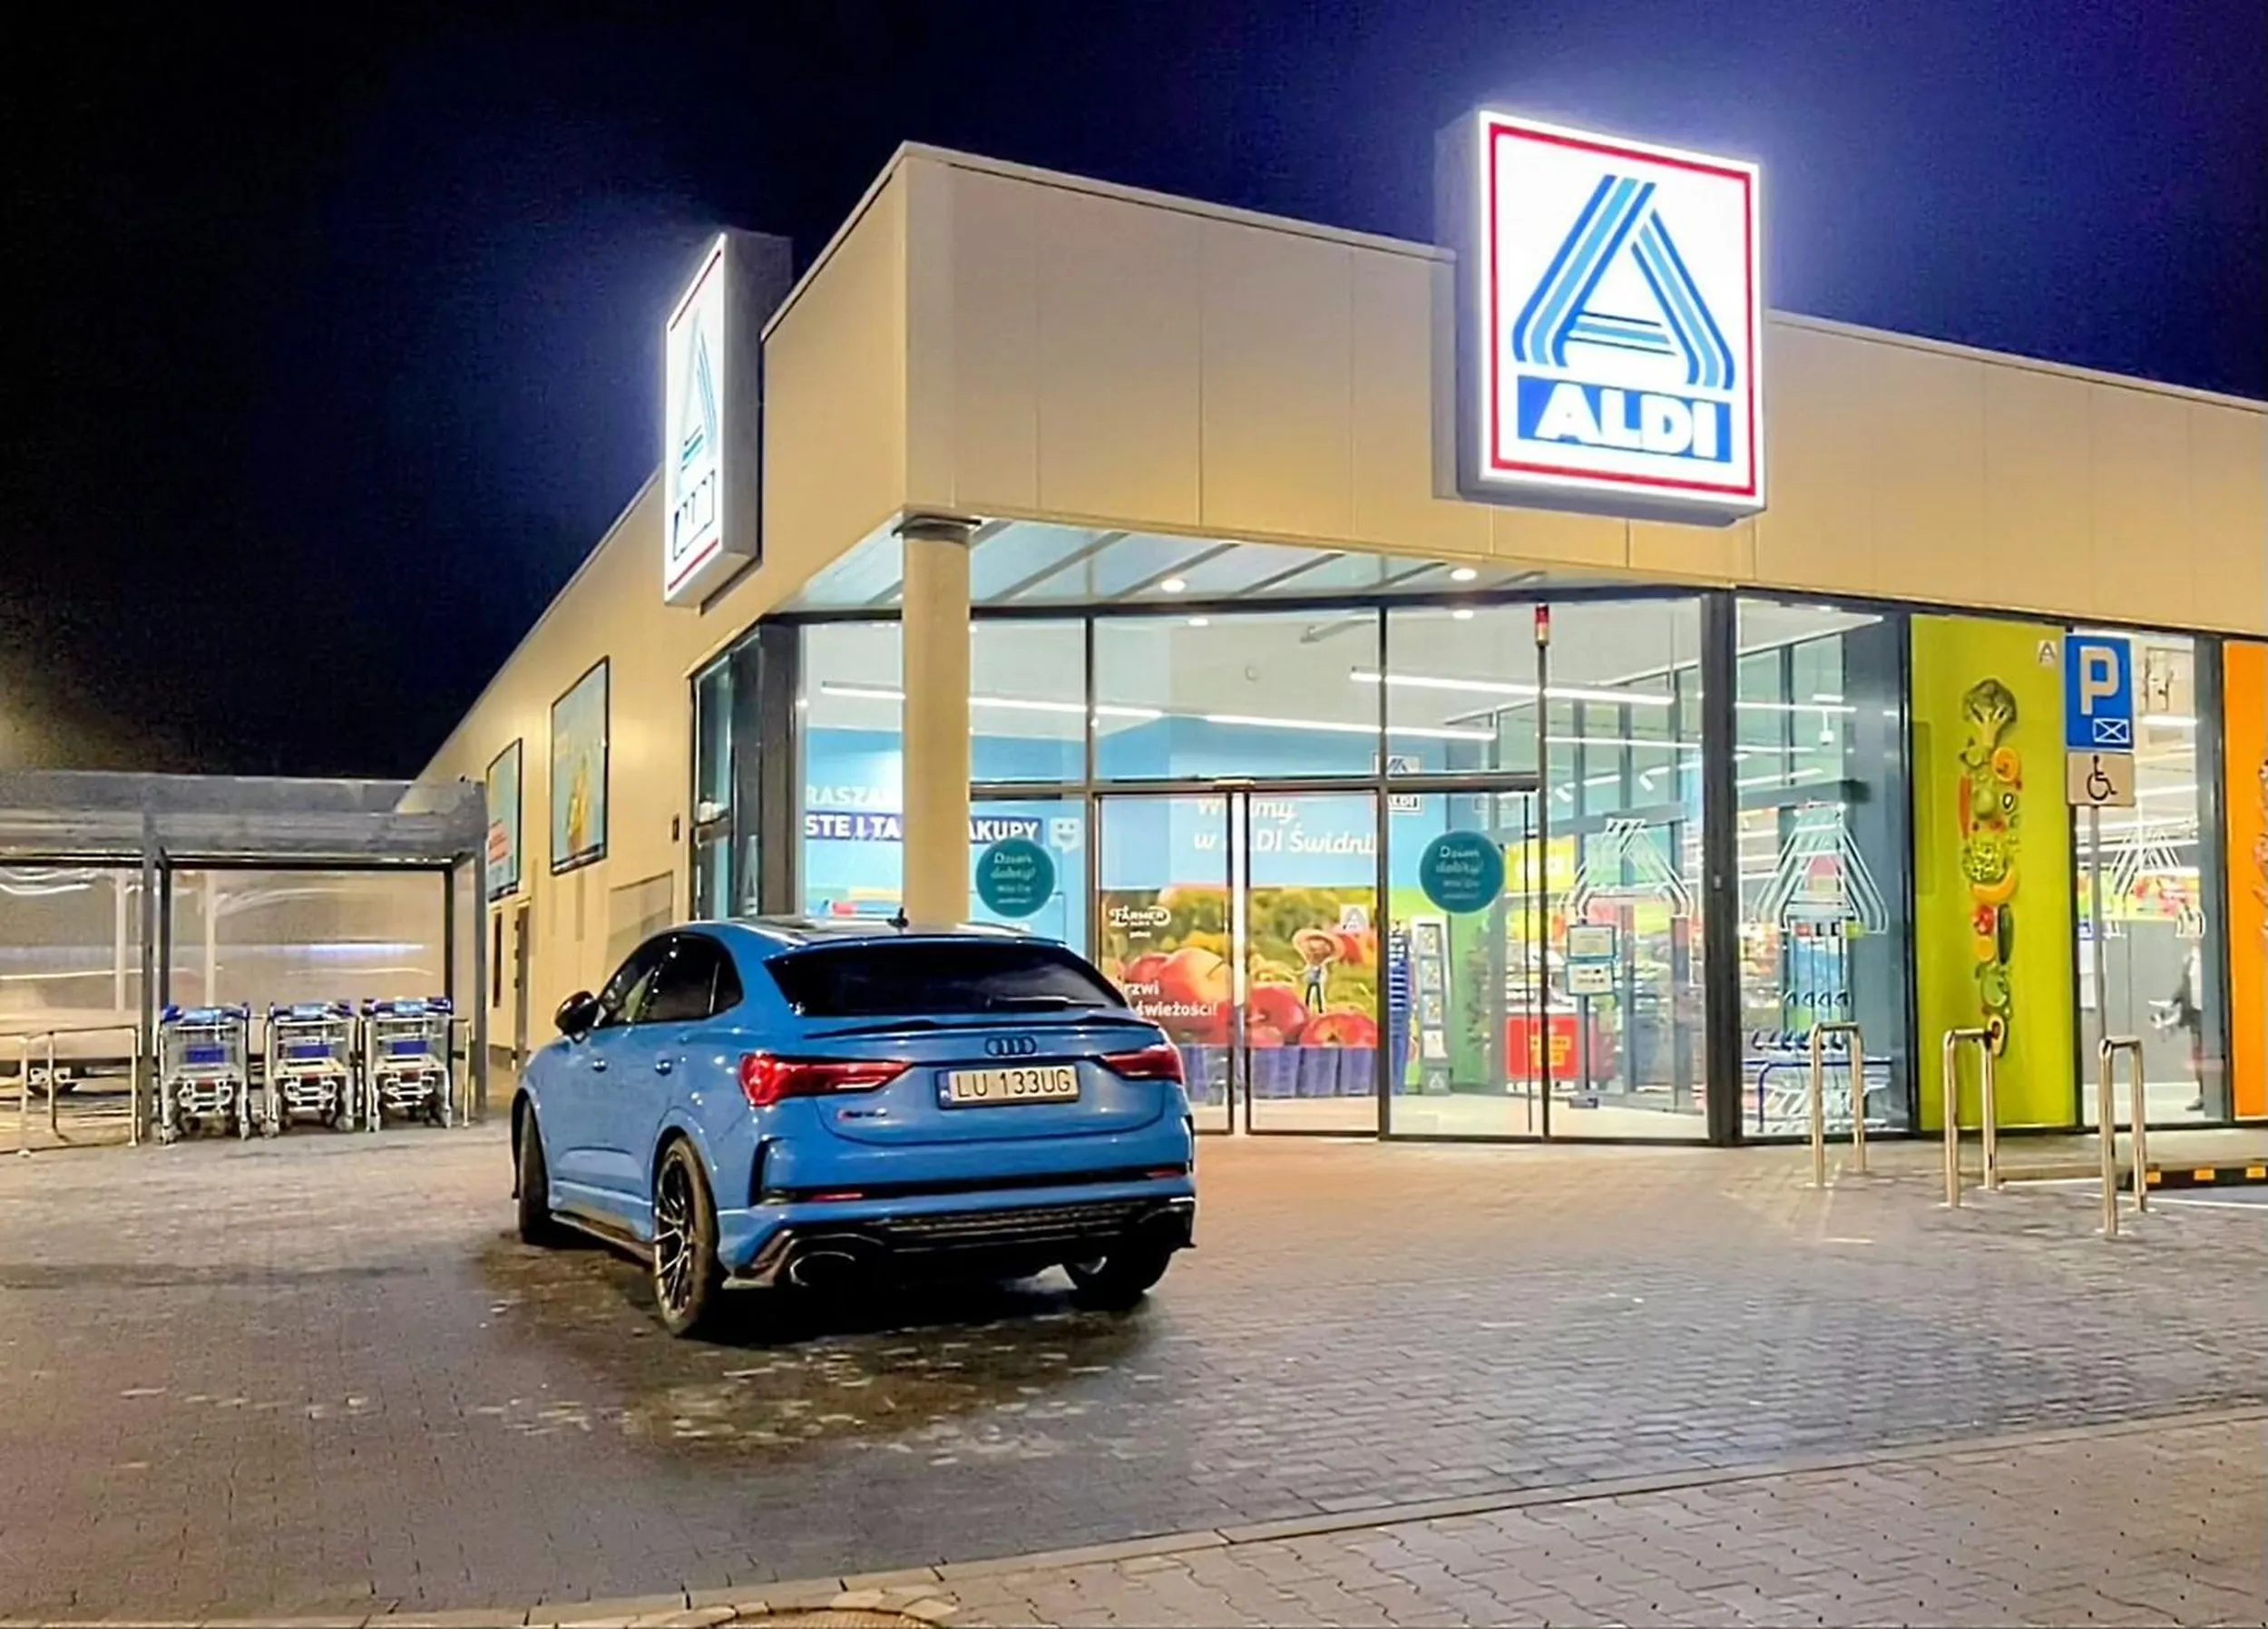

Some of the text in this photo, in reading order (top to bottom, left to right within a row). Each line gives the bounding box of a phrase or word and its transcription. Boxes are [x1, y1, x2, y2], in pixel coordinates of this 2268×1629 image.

[1533, 381, 1717, 459] ALDI
[2079, 646, 2119, 715] P
[1288, 822, 1377, 854] Świdni
[955, 1068, 1070, 1098] LU 133UG
